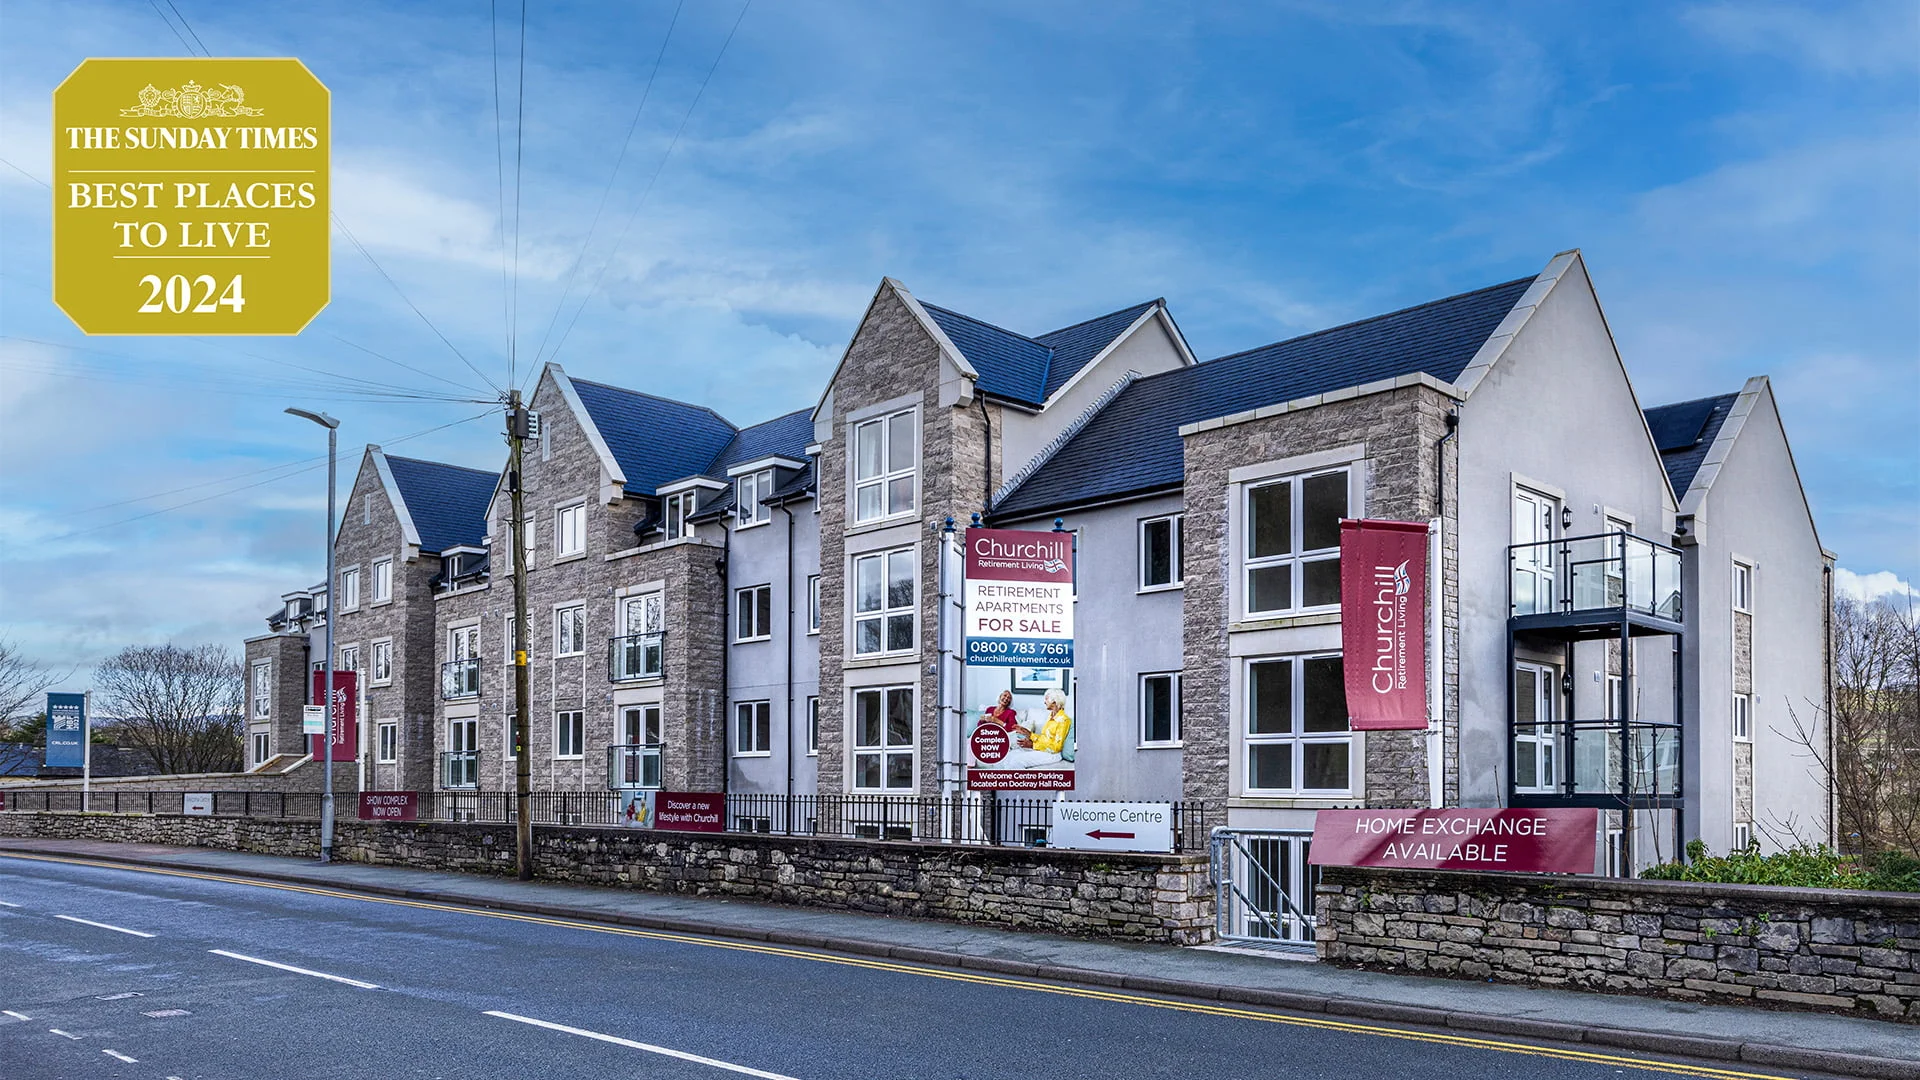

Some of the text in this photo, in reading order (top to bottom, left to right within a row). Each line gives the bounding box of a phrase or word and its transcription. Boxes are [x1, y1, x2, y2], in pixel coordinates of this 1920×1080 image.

[975, 538, 1064, 559] Churchill
[978, 560, 1044, 571] Retirement Living
[978, 585, 1061, 598] RETIREMENT
[975, 601, 1064, 614] APARTMENTS
[978, 618, 1061, 633] FOR SALE
[1371, 566, 1395, 694] Churchill
[970, 641, 1069, 655] 0800 783 7661
[1397, 596, 1408, 689] Retirement Living
[970, 655, 1071, 664] churchillretirement.co.uk
[978, 772, 1064, 781] Welcome Centre Parking
[1009, 781, 1038, 789] Dockray
[366, 795, 408, 806] SHOW COMPLEX
[667, 801, 691, 809] Discover
[697, 802, 710, 810] new
[372, 806, 402, 816] NOW OPEN
[658, 812, 719, 823] lifestyle with Churchill
[1060, 808, 1163, 823] Welcome Centre
[1355, 817, 1547, 836] HOME EXCHANGE
[1382, 843, 1508, 862] AVAILABLE
